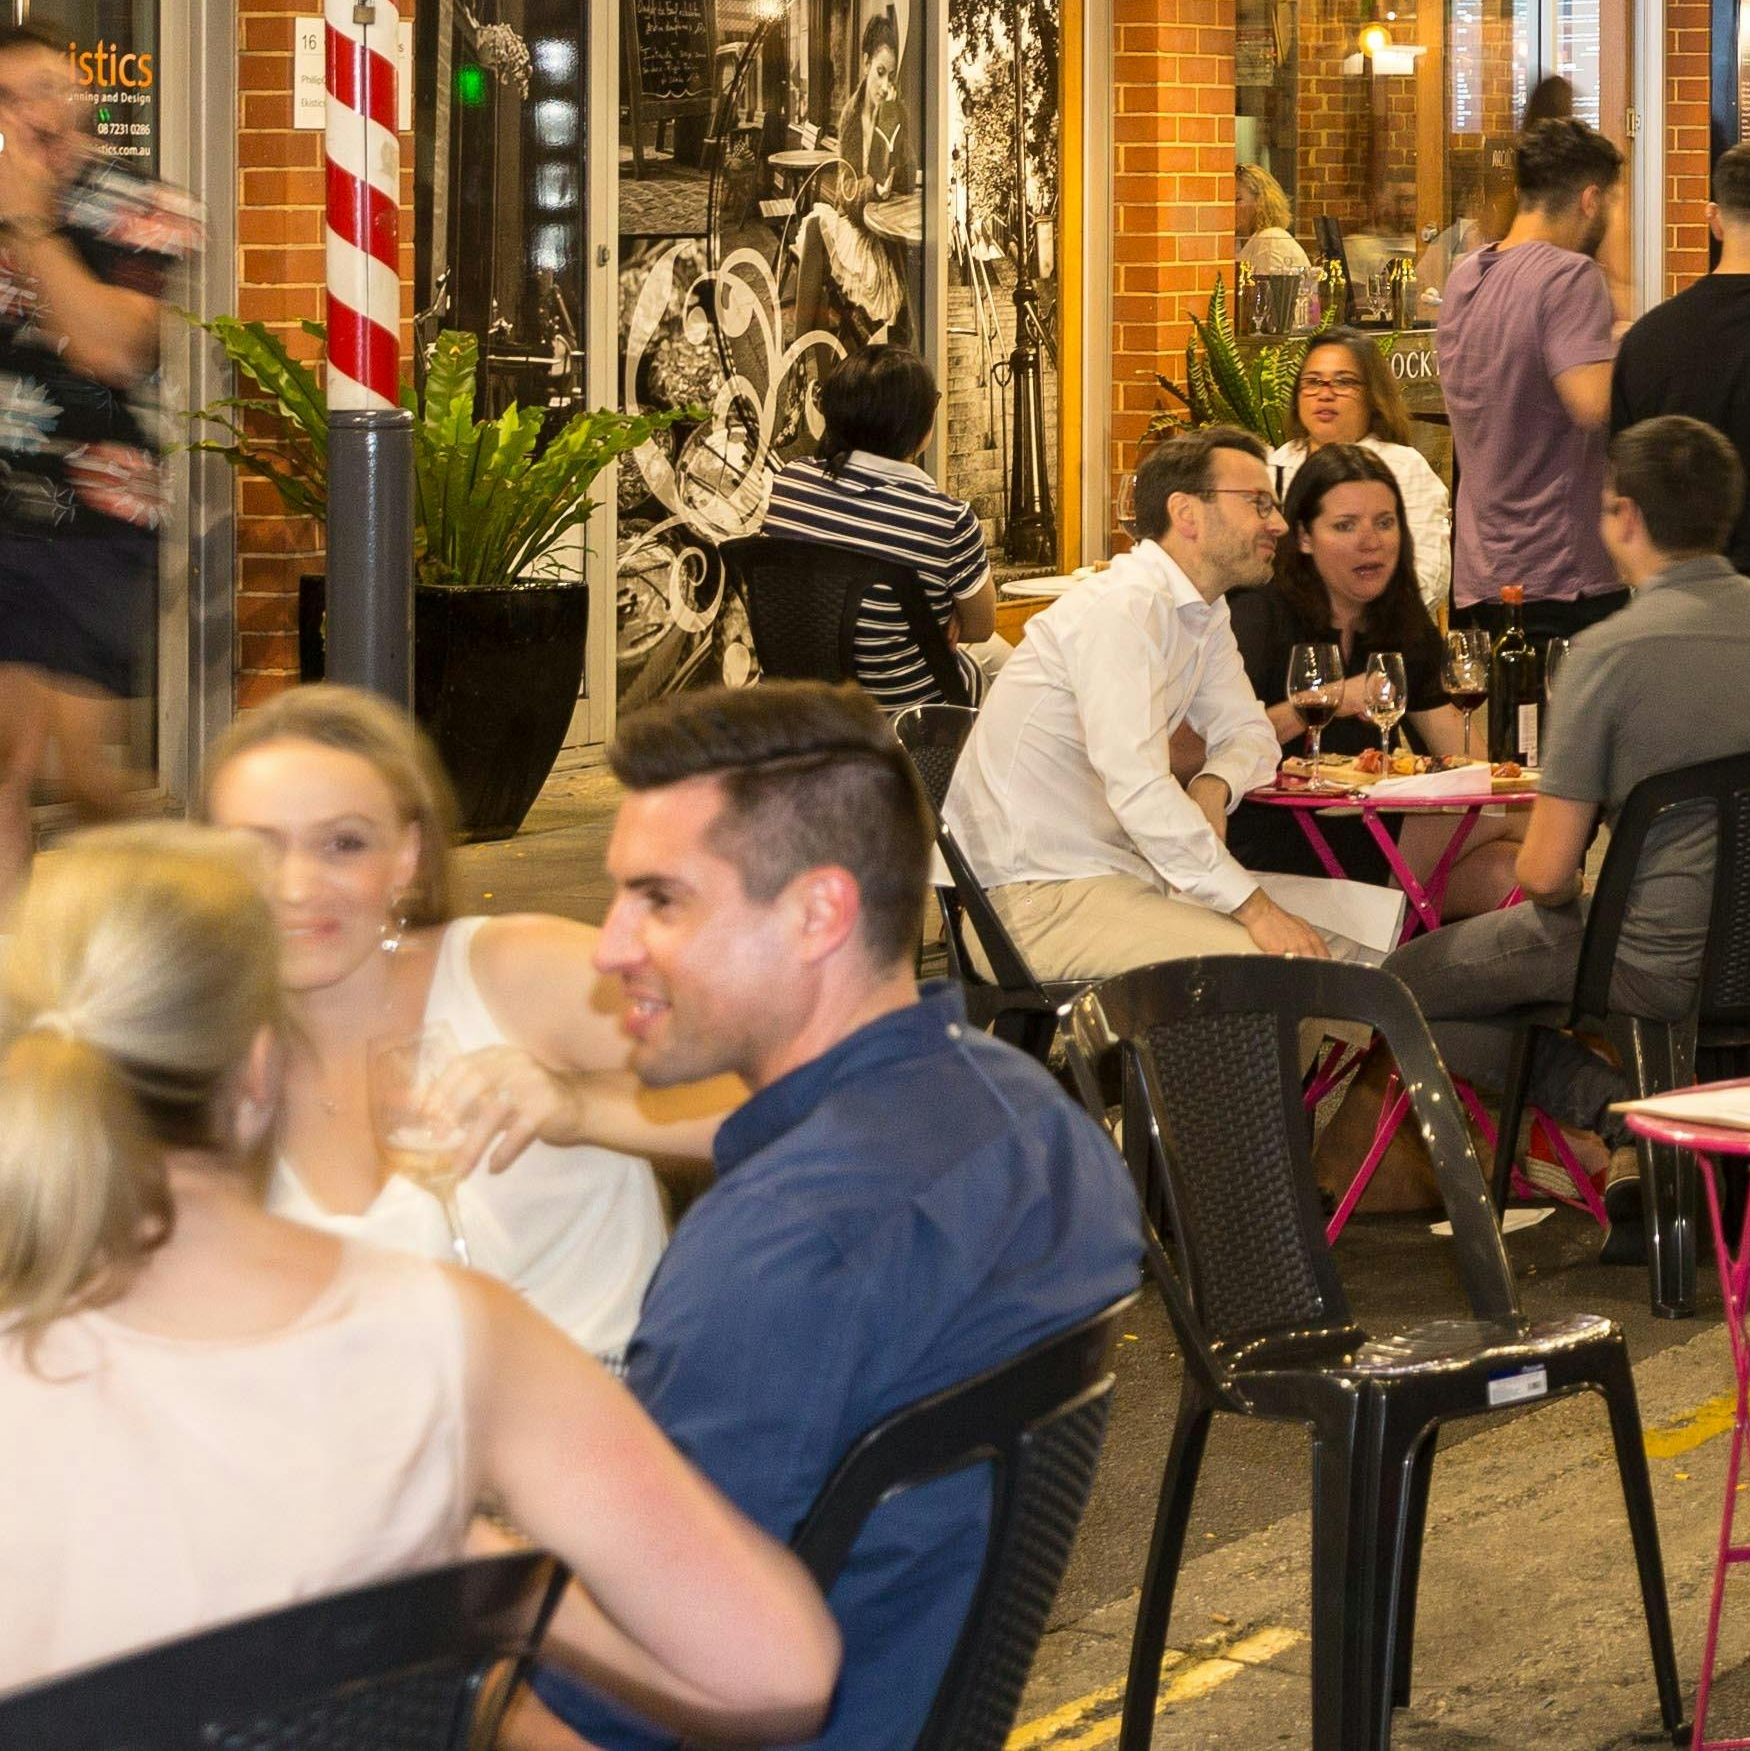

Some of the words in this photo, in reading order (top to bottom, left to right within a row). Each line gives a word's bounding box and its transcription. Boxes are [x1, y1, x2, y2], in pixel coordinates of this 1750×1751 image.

[301, 33, 318, 51] 16
[68, 40, 153, 88] istics
[101, 91, 119, 104] and
[120, 91, 152, 107] Design
[97, 122, 109, 136] 08
[109, 122, 129, 136] 7231
[1391, 350, 1441, 380] OCKT
